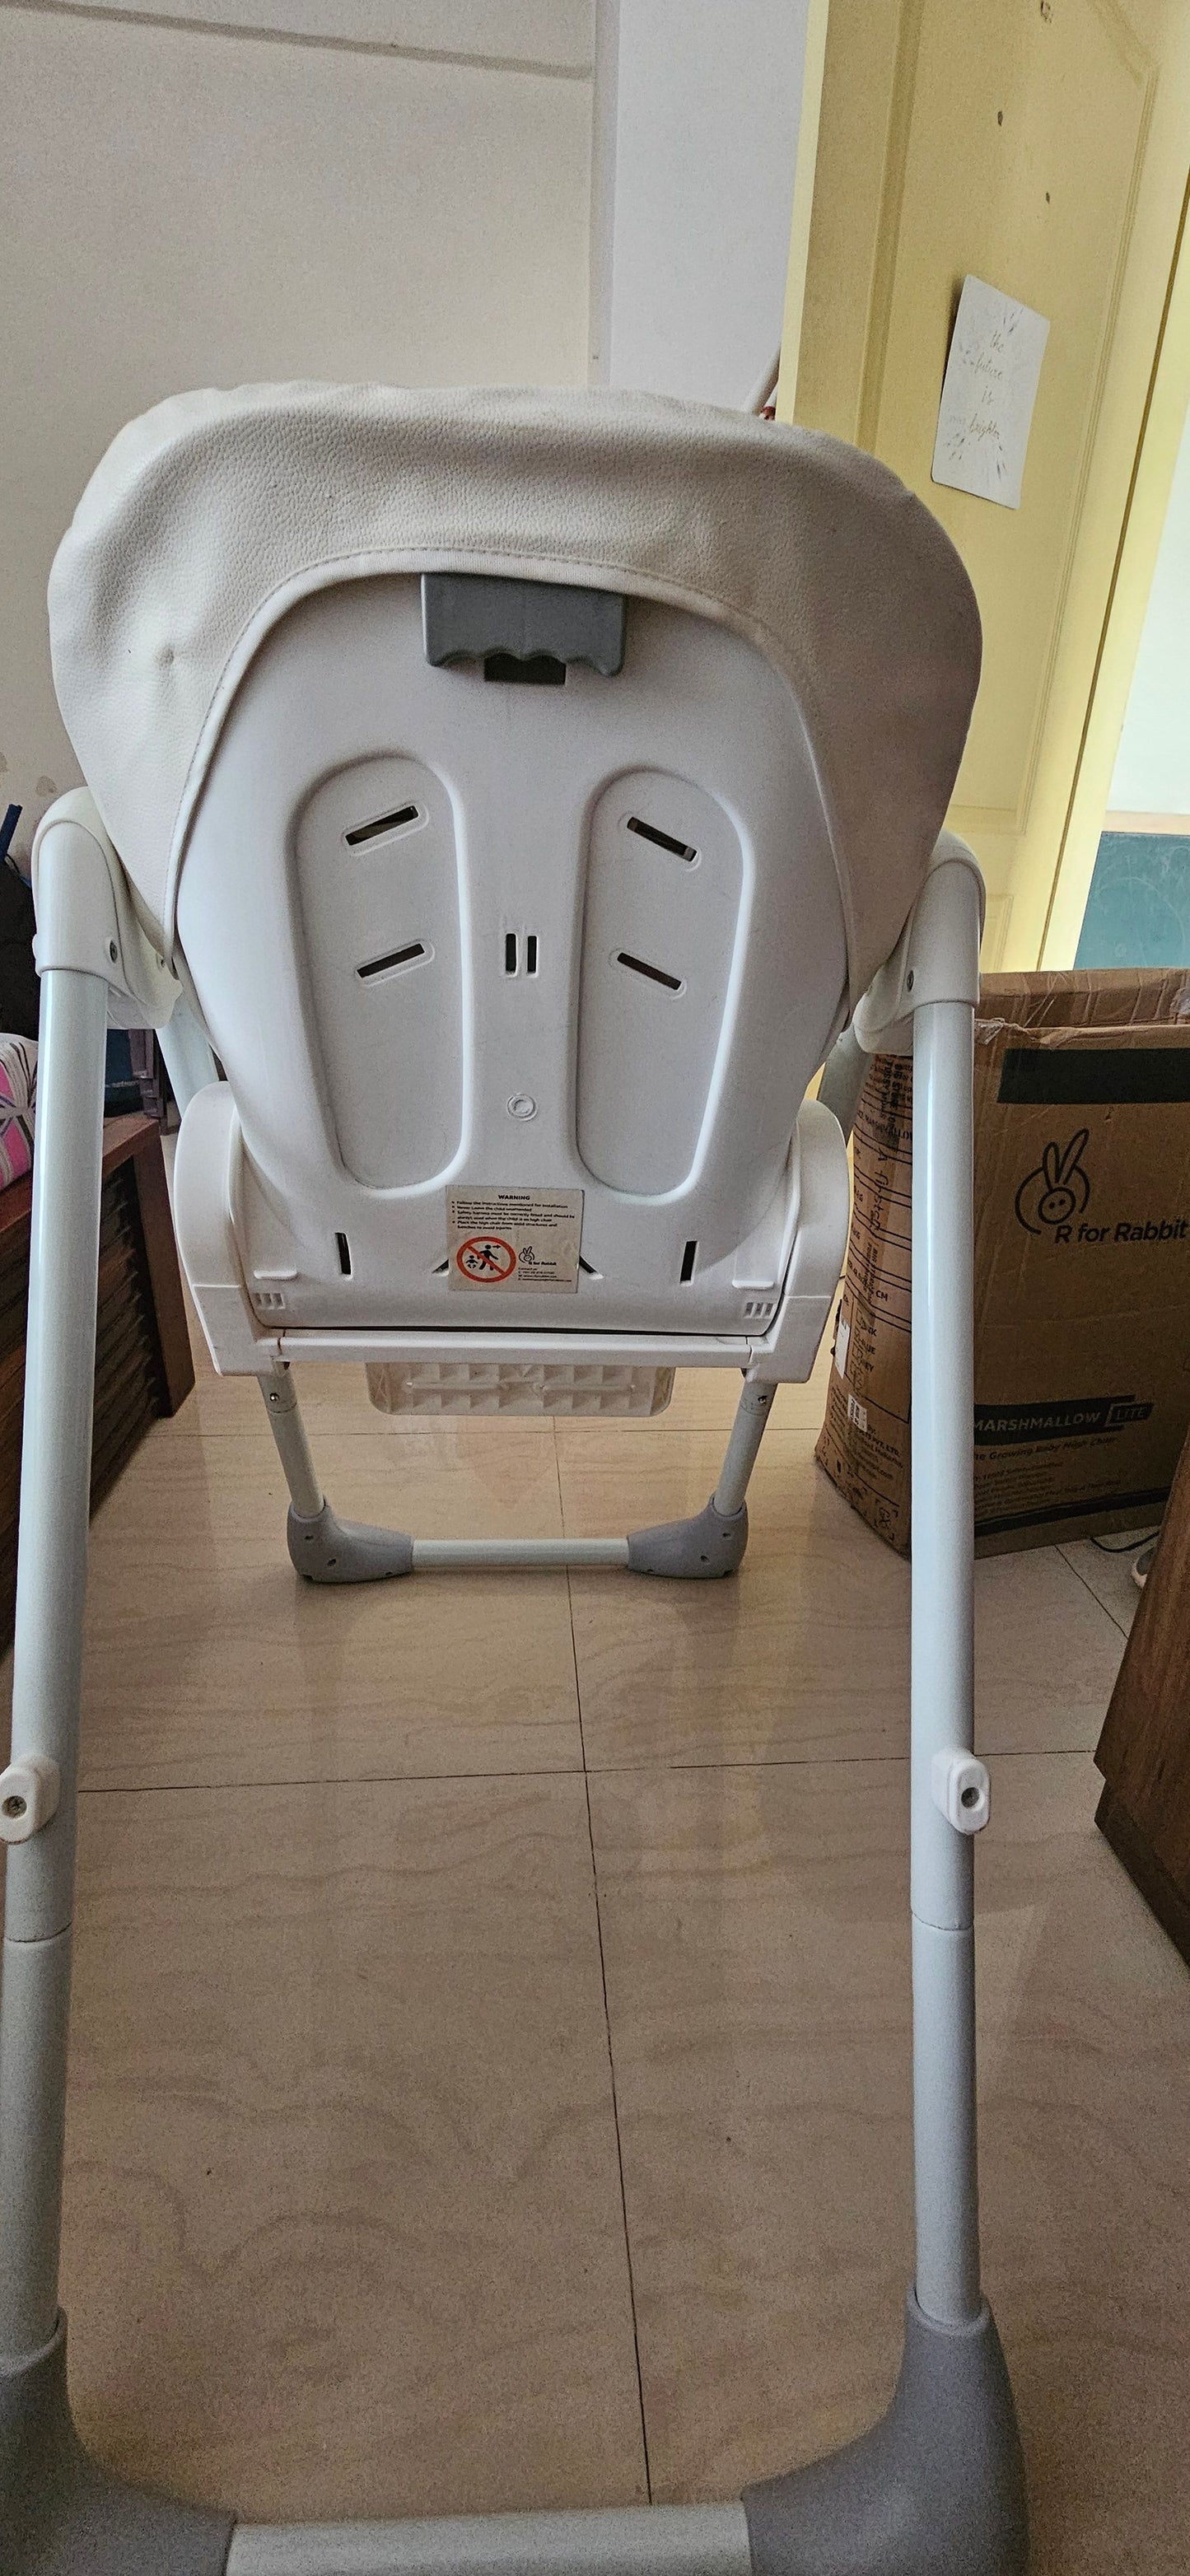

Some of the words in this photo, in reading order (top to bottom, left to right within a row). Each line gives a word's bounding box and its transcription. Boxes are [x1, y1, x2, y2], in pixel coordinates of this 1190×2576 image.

[990, 329, 1004, 352] the
[974, 352, 1002, 379] future
[981, 385, 994, 404] is
[1054, 1225, 1072, 1244] R
[1077, 1222, 1111, 1243] for
[1114, 1220, 1188, 1241] Rabbit
[875, 1290, 889, 1302] CM
[974, 1412, 1101, 1431] MARSHMALLOW
[1117, 1407, 1147, 1421] LITE
[974, 1452, 986, 1461] he
[989, 1448, 1034, 1460] Growing
